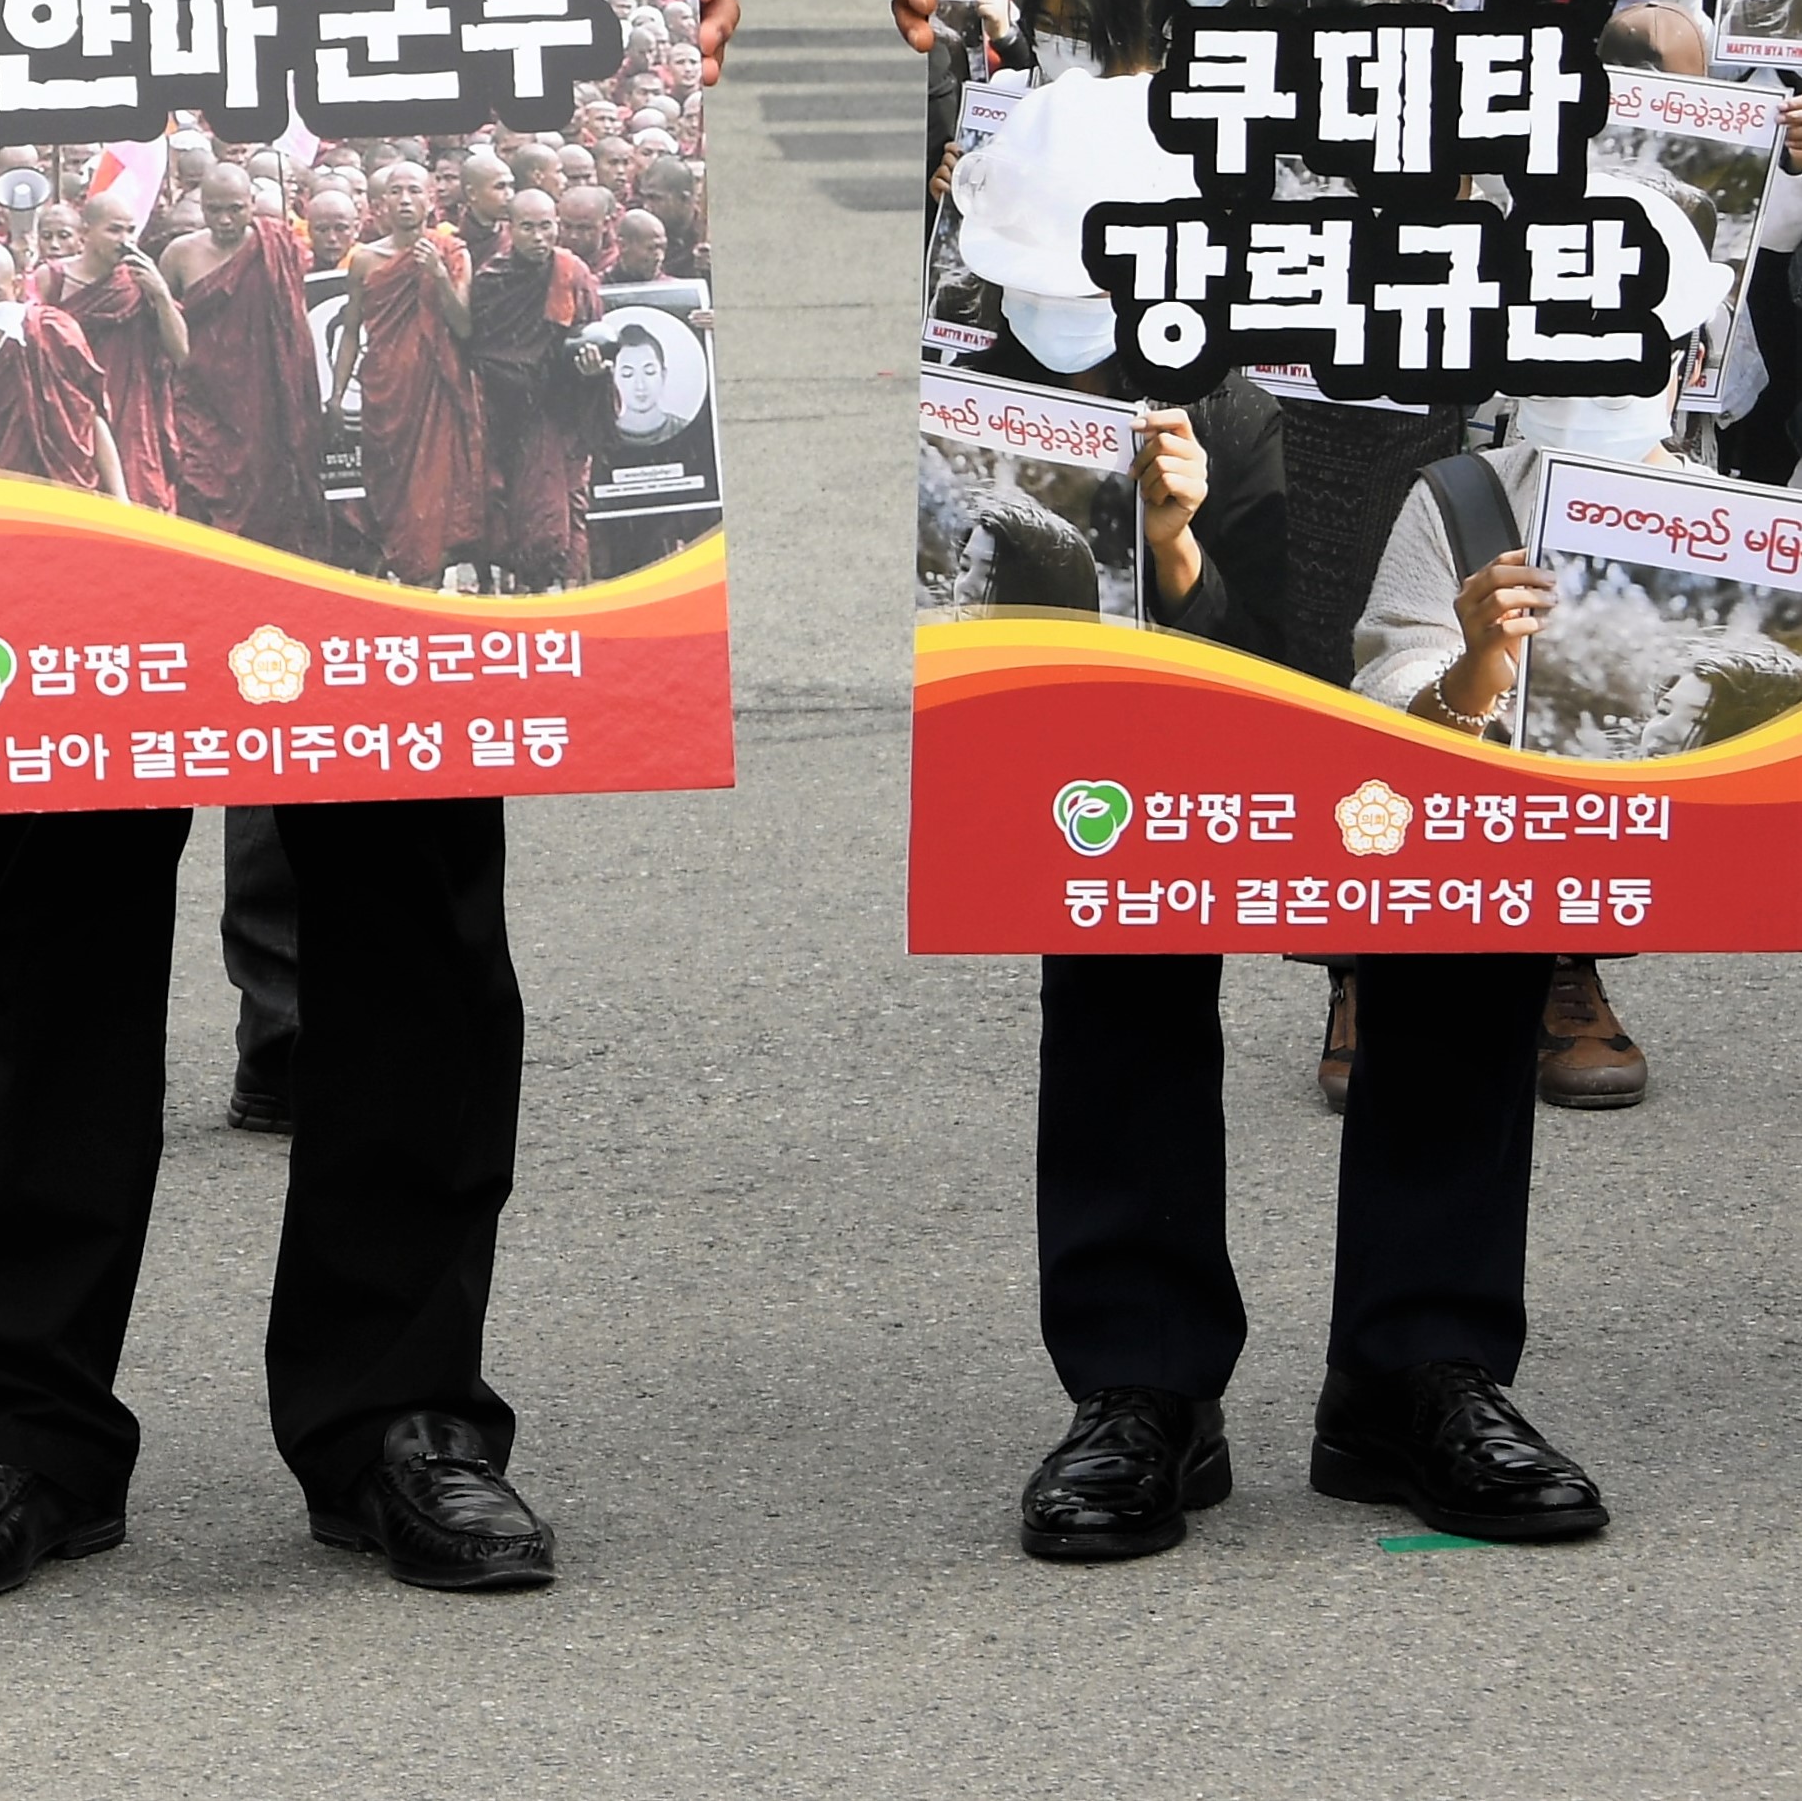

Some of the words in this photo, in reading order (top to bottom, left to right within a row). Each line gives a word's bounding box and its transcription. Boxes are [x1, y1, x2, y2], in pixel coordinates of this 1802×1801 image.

[1724, 44, 1761, 57] MARTYR
[1763, 46, 1783, 58] MYA
[1170, 27, 1581, 176] 쿠데타
[1104, 220, 1642, 369] 강력규탄
[931, 326, 961, 342] MARTYR
[962, 331, 978, 345] MYA
[1289, 366, 1308, 379] MYA
[29, 643, 187, 695] 함평군
[321, 630, 581, 685] 함평군의회
[132, 722, 442, 778] 결혼이주여성
[468, 718, 568, 766] 일동
[1145, 793, 1295, 842] 함평군
[1424, 794, 1669, 842] 함평군의회
[1065, 881, 1215, 926] 동남아
[1237, 877, 1532, 925] 결혼이주여성
[1558, 878, 1651, 925] 일동
